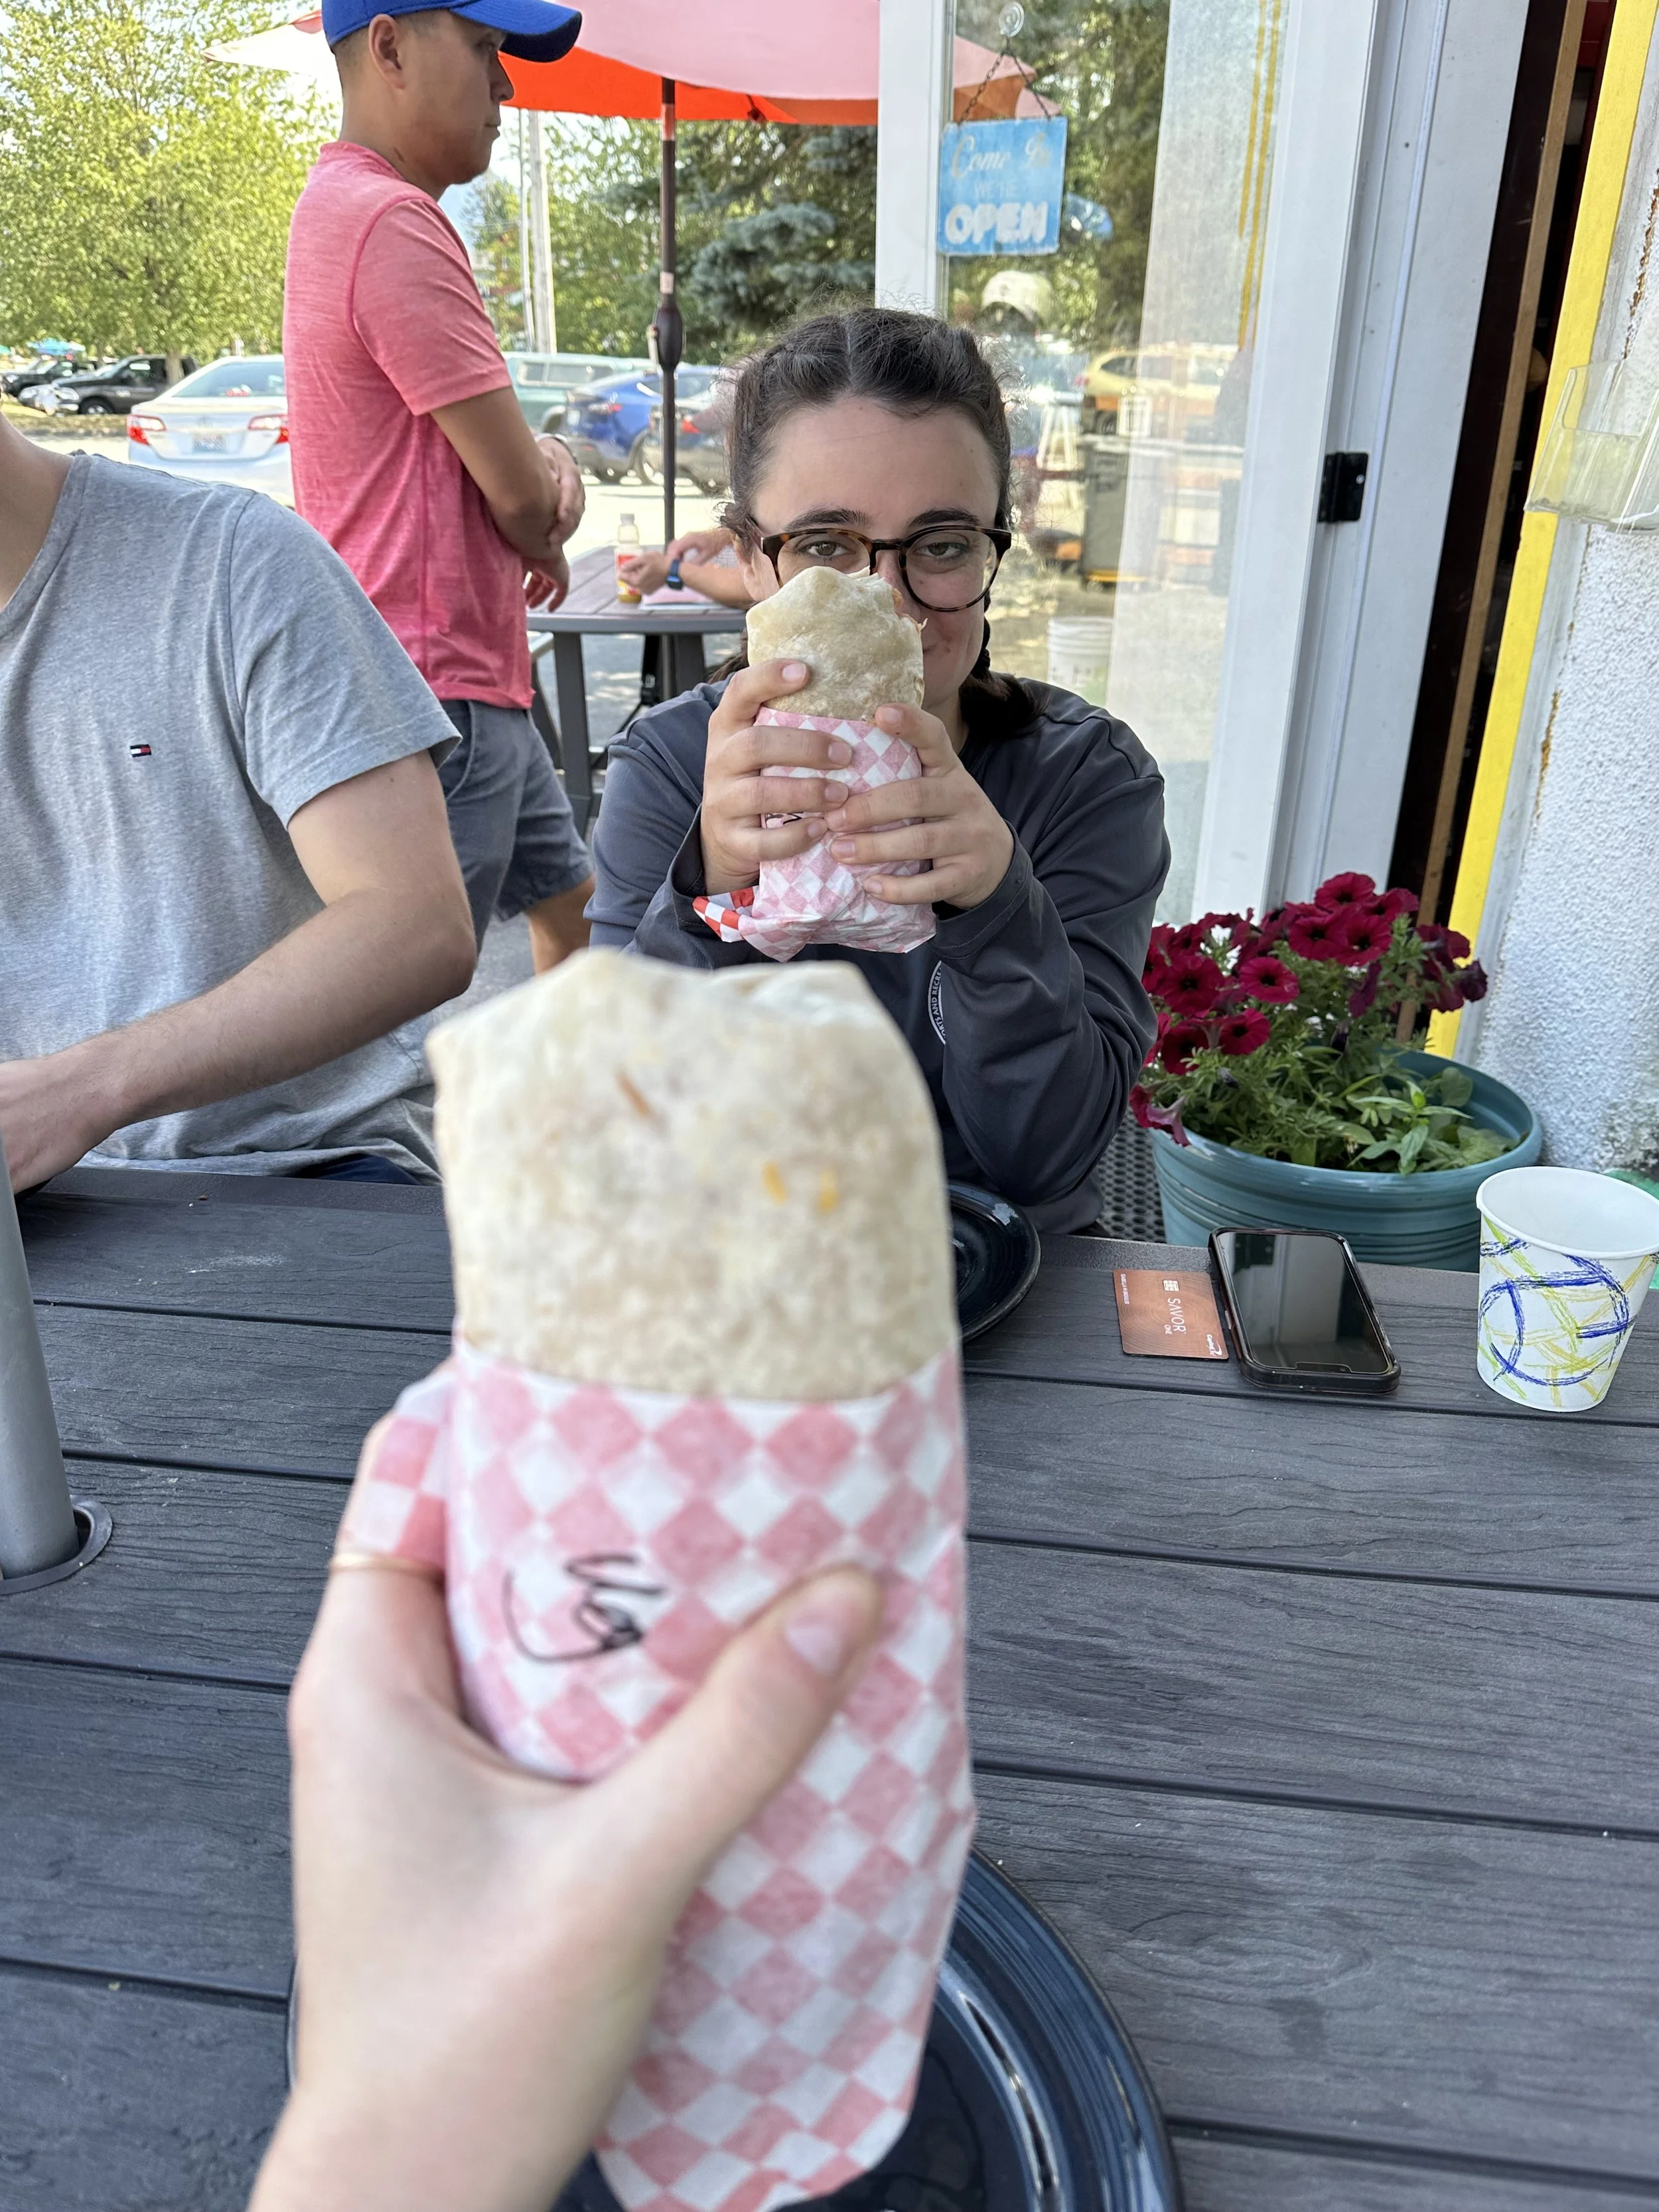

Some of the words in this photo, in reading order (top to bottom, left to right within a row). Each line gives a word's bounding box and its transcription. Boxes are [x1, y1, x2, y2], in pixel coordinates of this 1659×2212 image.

[944, 201, 1048, 244] OPEN
[1164, 1325, 1173, 1335] ONE
[1167, 1297, 1186, 1333] SAVOR
